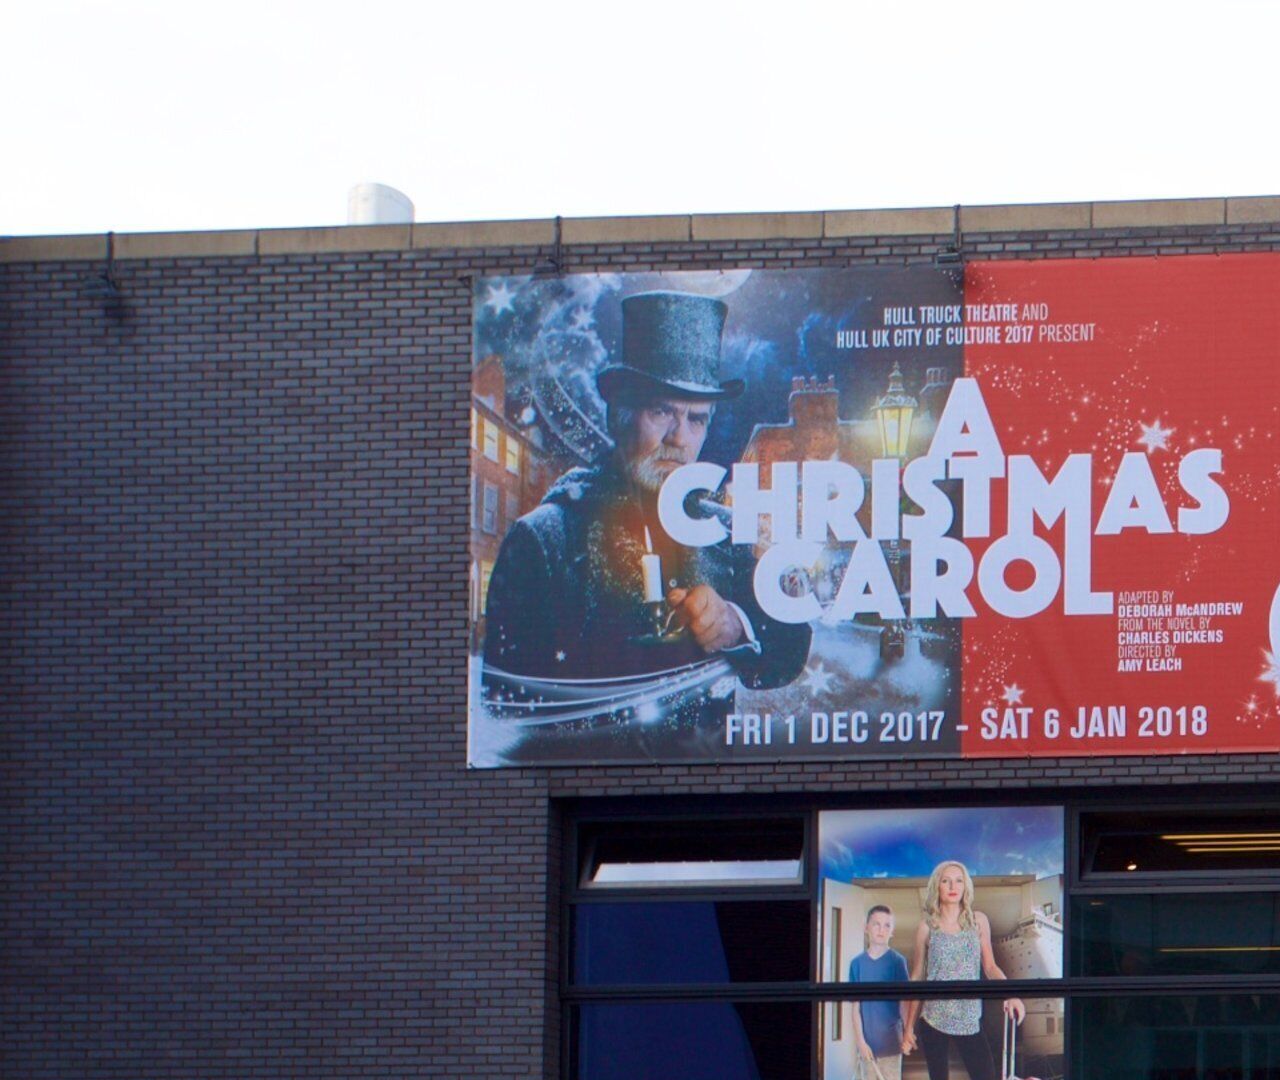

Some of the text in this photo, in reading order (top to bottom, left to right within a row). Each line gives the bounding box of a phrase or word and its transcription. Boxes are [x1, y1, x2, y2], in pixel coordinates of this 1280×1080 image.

[884, 303, 1048, 326] HULL TRUCK THEATRE AND
[837, 323, 1096, 349] HULL UK CITY OF CULTURE 2017 PRESENT
[927, 378, 1003, 459] A
[657, 448, 1230, 547] CHRISTMAS
[753, 534, 1114, 624] CAROL
[1118, 591, 1174, 604] ADAPTED BY
[1118, 602, 1243, 617] DEBORAH McANDREW
[1118, 617, 1211, 631] FROM THE NOVEL BY
[1118, 630, 1223, 645] CHARLES DICKENS
[1118, 645, 1176, 658] DIRECTED BY
[1118, 658, 1182, 672] AMY LEACH
[726, 714, 772, 745] FRI
[784, 714, 796, 744] 1
[811, 711, 869, 743] DEC
[880, 710, 945, 741] 2017
[981, 709, 1032, 740] SAT
[1044, 709, 1059, 739] 6
[1070, 707, 1128, 738] JAN
[1139, 706, 1208, 737] 2018
